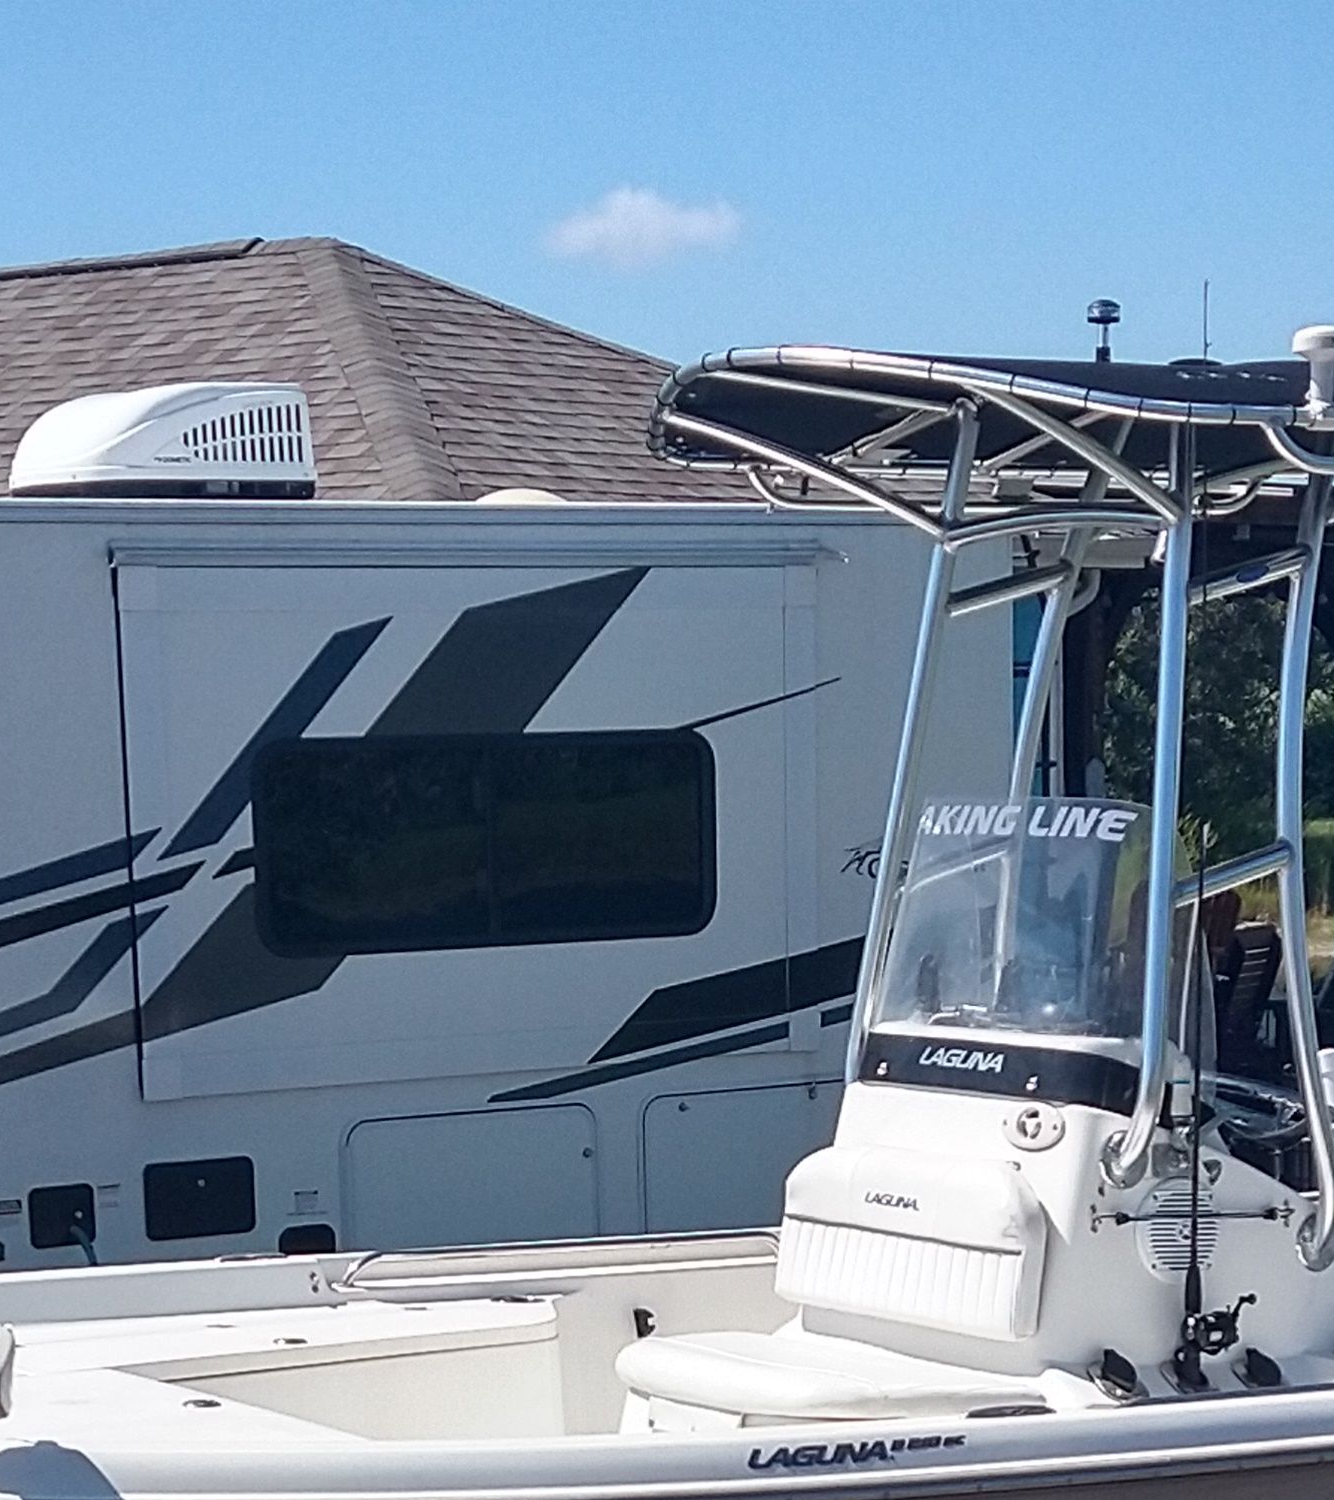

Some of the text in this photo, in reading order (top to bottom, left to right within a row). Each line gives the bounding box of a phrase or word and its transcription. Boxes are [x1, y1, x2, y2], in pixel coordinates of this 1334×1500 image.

[920, 805, 1138, 841] AKING LINE
[919, 1046, 1005, 1073] LAGUNA
[864, 1192, 920, 1212] LAGUNA
[748, 1440, 888, 1469] LAGUNA
